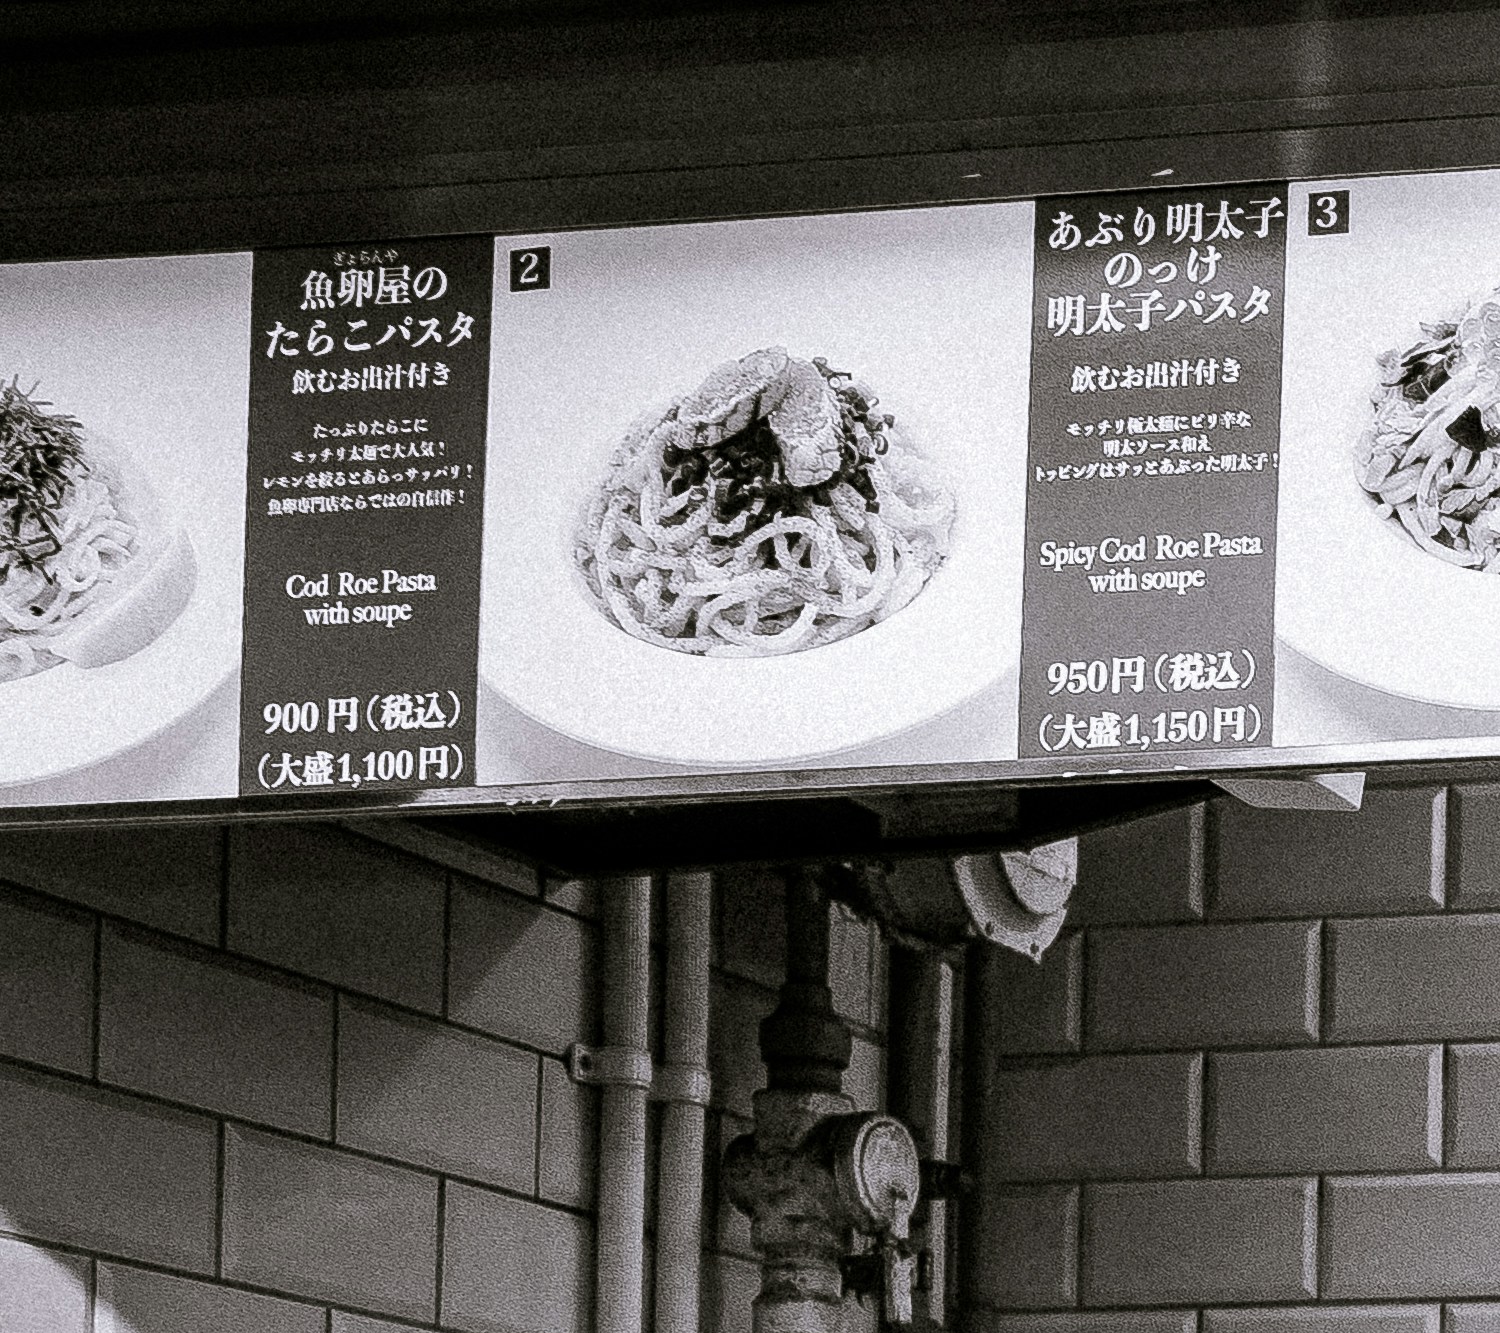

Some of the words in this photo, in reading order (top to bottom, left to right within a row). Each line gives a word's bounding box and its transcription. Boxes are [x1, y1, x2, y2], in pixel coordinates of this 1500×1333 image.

[1048, 197, 1285, 250] あぶり明太子
[1315, 196, 1338, 229] 3
[519, 253, 539, 284] 2
[1104, 245, 1223, 288] のっけ
[300, 265, 448, 310] 魚卵屋の
[1046, 285, 1272, 337] 明太子パスタ
[266, 311, 475, 359] たらこパスタ
[292, 361, 450, 394] 飲むお出汁付き
[1070, 357, 1242, 394] 飲むお出汁付き
[313, 418, 428, 439] たっぷりたらこに
[1102, 434, 1212, 459] 明太ソース和え
[1039, 541, 1098, 572] Spicy
[1100, 535, 1146, 564] Cod
[1155, 534, 1200, 561] Roe
[1202, 532, 1263, 559] Pasta
[285, 574, 330, 600] Cod
[337, 571, 379, 597] Roe
[381, 569, 437, 595] Pasta
[1088, 568, 1139, 593] with
[1140, 568, 1207, 596] soupe
[304, 601, 349, 627] with
[352, 599, 413, 629] soupe
